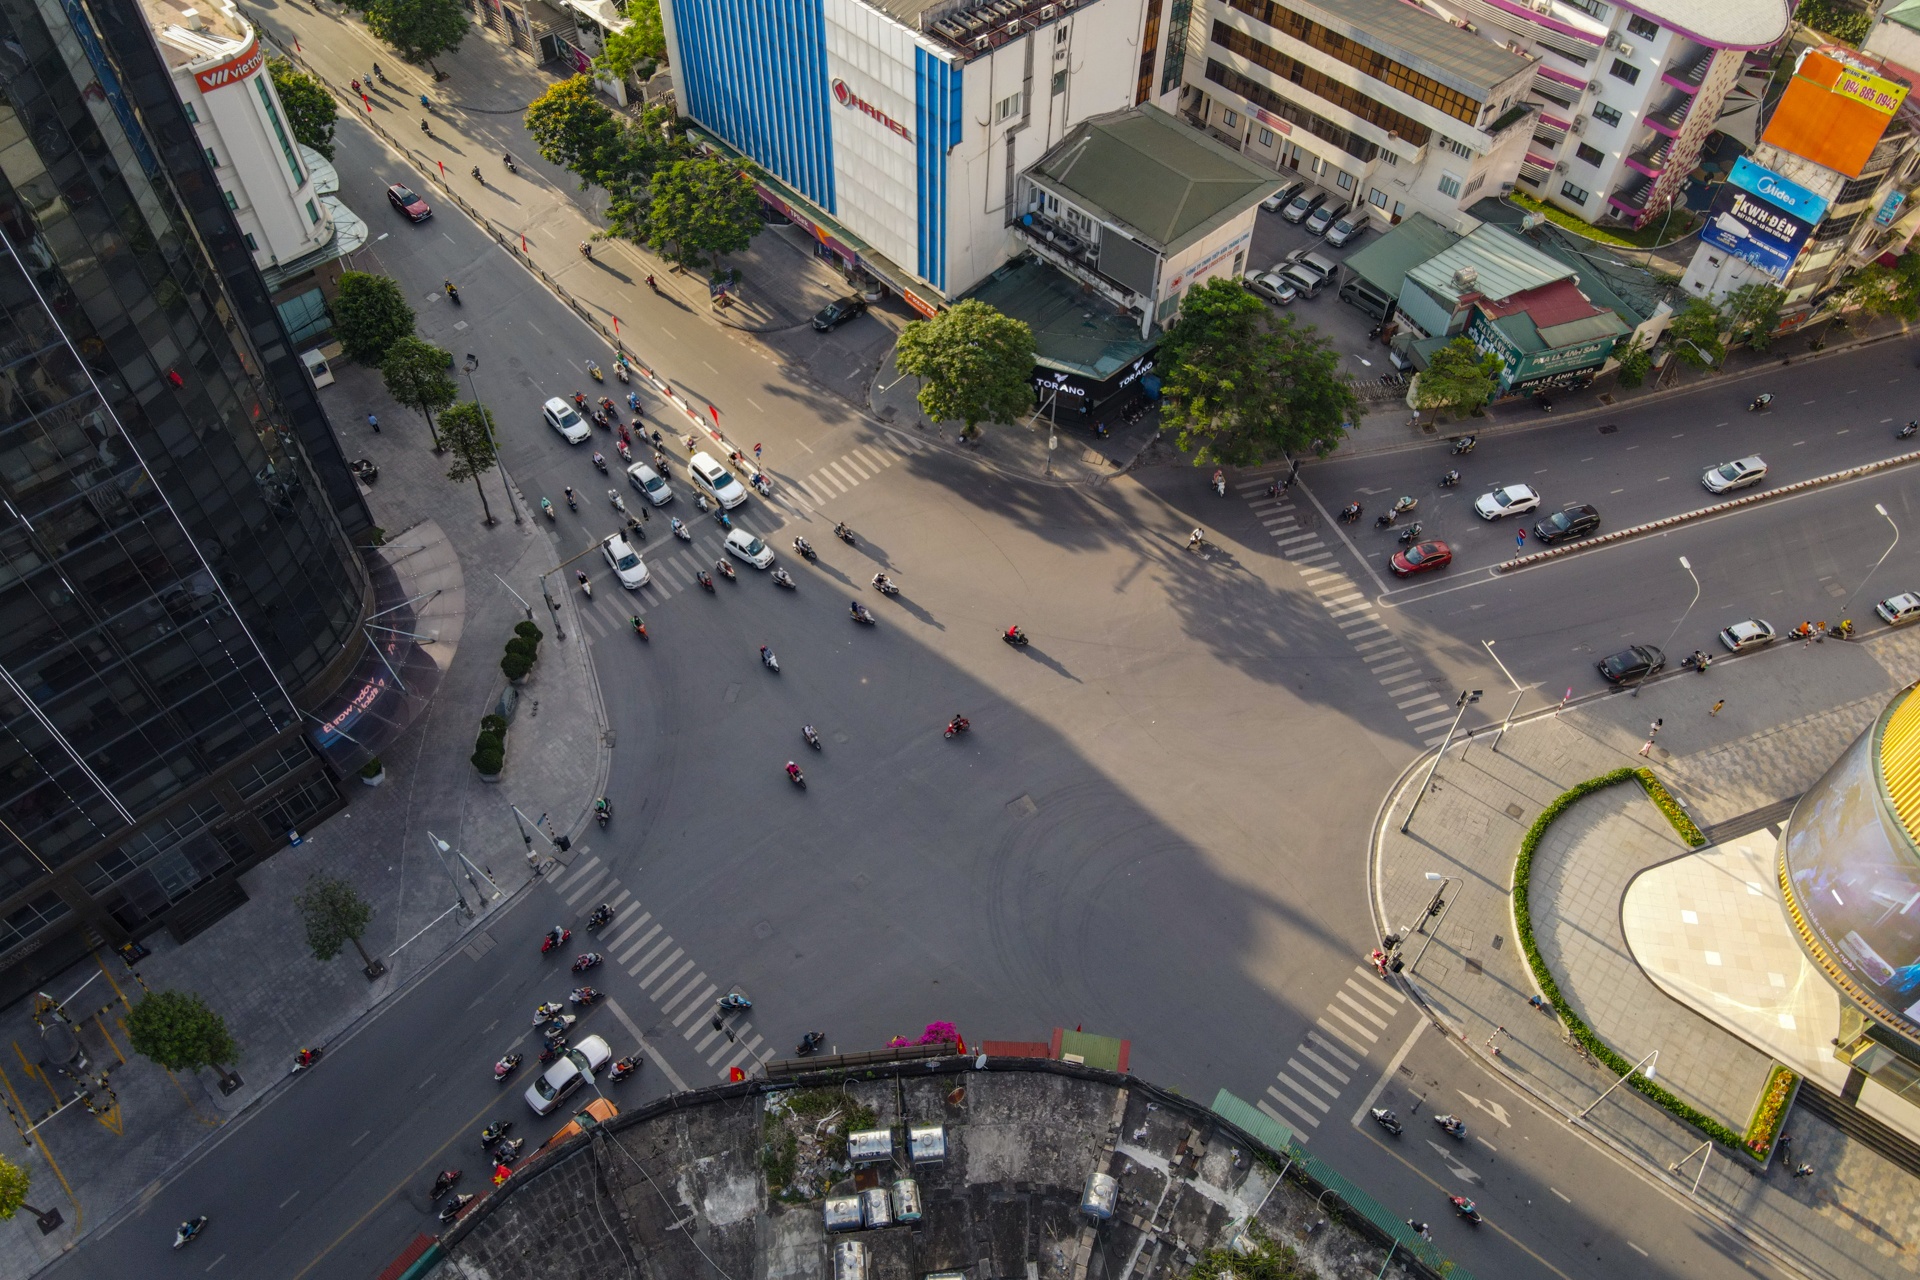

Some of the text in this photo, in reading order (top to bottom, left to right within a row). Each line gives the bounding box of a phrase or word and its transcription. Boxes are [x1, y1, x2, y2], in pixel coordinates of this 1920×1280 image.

[1843, 80, 1898, 110] 094 885 0943
[852, 94, 913, 142] HANEL
[1760, 179, 1796, 205] Midea
[1119, 362, 1152, 388] TORANO
[1576, 368, 1594, 376] SAO
[1037, 378, 1085, 396] TORANO
